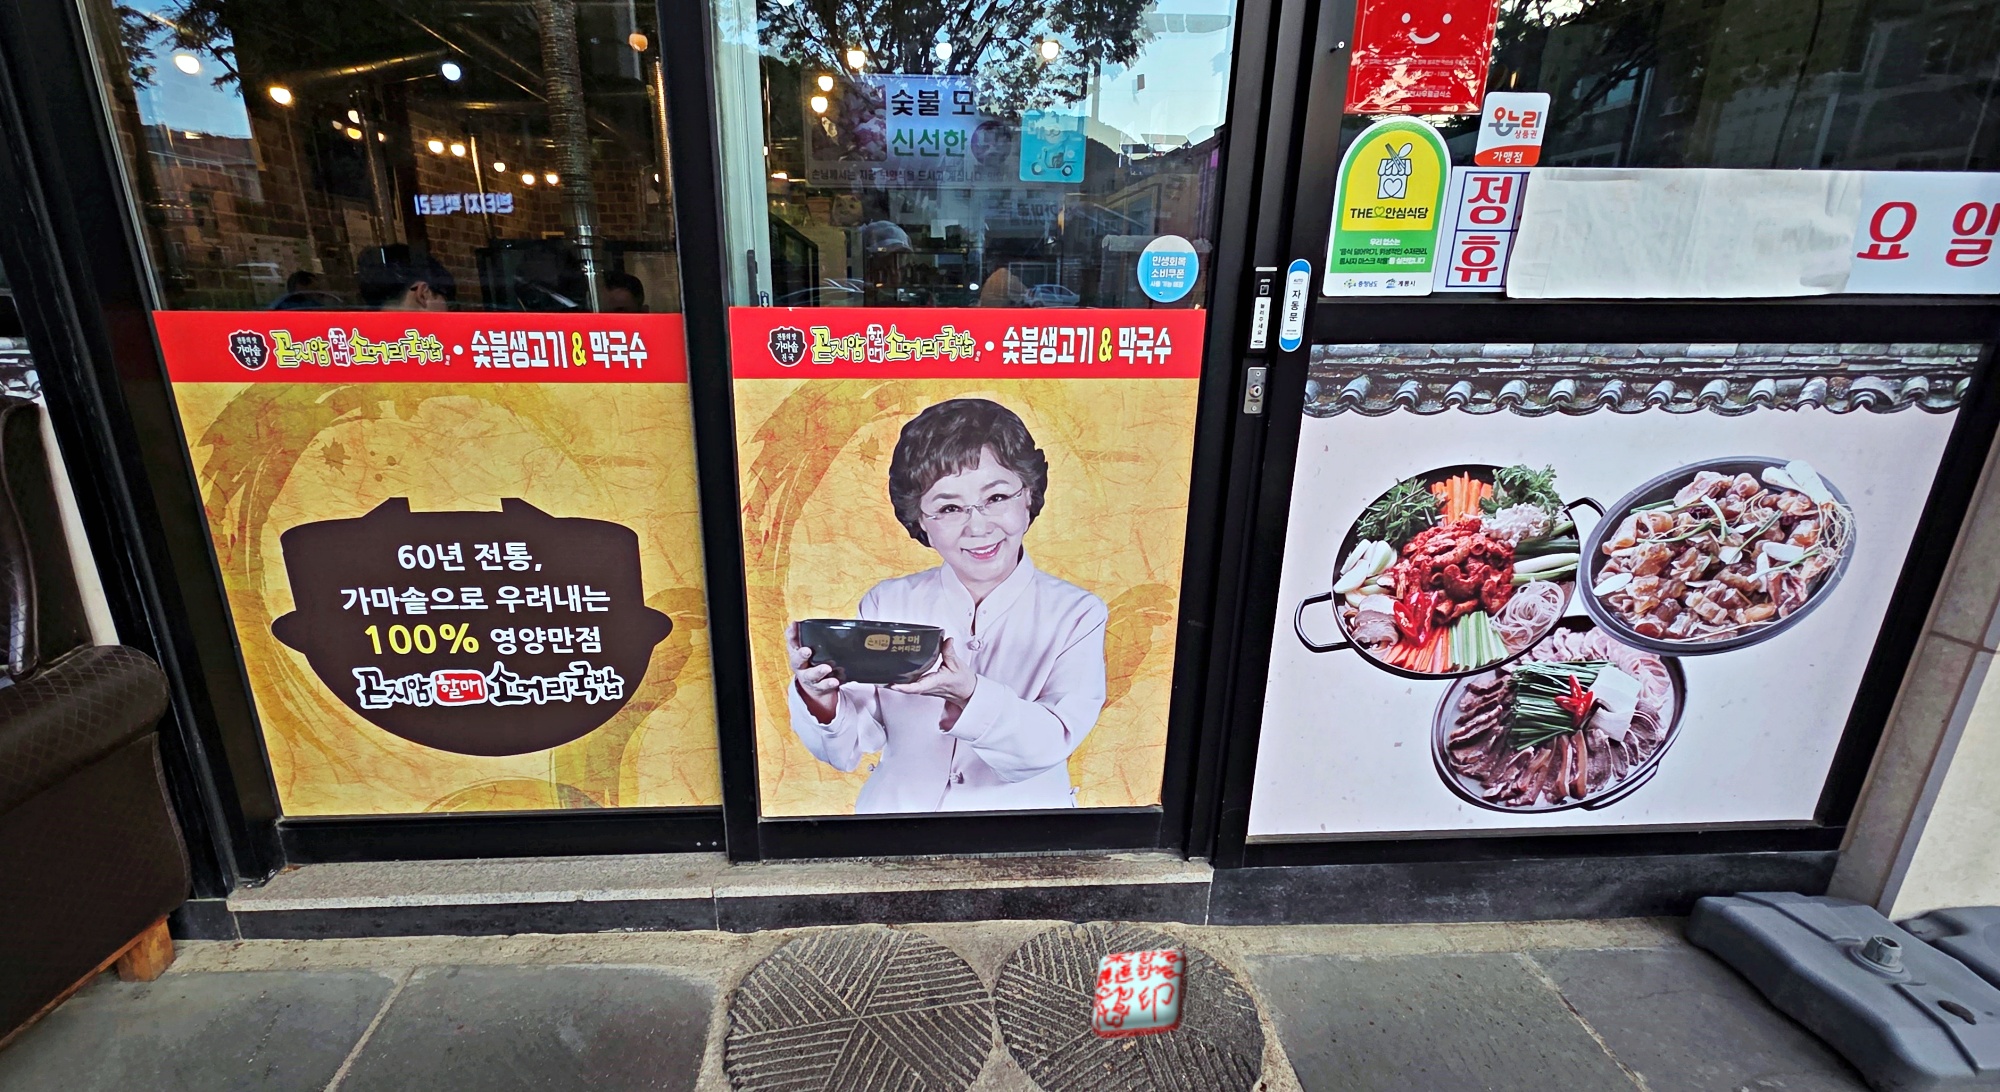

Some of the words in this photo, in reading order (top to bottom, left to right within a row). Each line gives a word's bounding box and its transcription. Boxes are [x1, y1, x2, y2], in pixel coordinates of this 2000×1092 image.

[891, 89, 941, 116] 숯불
[952, 90, 975, 116] 모
[891, 128, 968, 157] 신선한
[1514, 130, 1538, 139] 상품권
[1493, 151, 1524, 164] 가맹점
[1350, 207, 1373, 219] THE
[1385, 206, 1429, 219] 안심식당
[1151, 268, 1185, 279] 소비쿠폰
[1152, 256, 1187, 267] 민생회복
[1288, 289, 1302, 322] 자동문
[236, 344, 262, 357] 가마솥
[349, 328, 444, 366] 소머리국밥
[471, 330, 568, 368] 숯불생고기
[571, 331, 587, 367] &
[589, 330, 648, 368] 막국수
[775, 340, 799, 353] 가마솥
[884, 323, 975, 361] 소머리국밥
[1002, 326, 1094, 364] 숯불생고기
[1098, 327, 1113, 363] &
[1118, 326, 1172, 364] 막국수
[397, 542, 466, 571] 60년
[474, 541, 543, 572] 전통,
[340, 585, 489, 616] 가마솥으로
[495, 584, 611, 614] 우려내는
[364, 623, 480, 655] 100%
[490, 626, 602, 655] 영양만점
[434, 671, 485, 700] 할매
[487, 660, 625, 705] 소머리국밥
